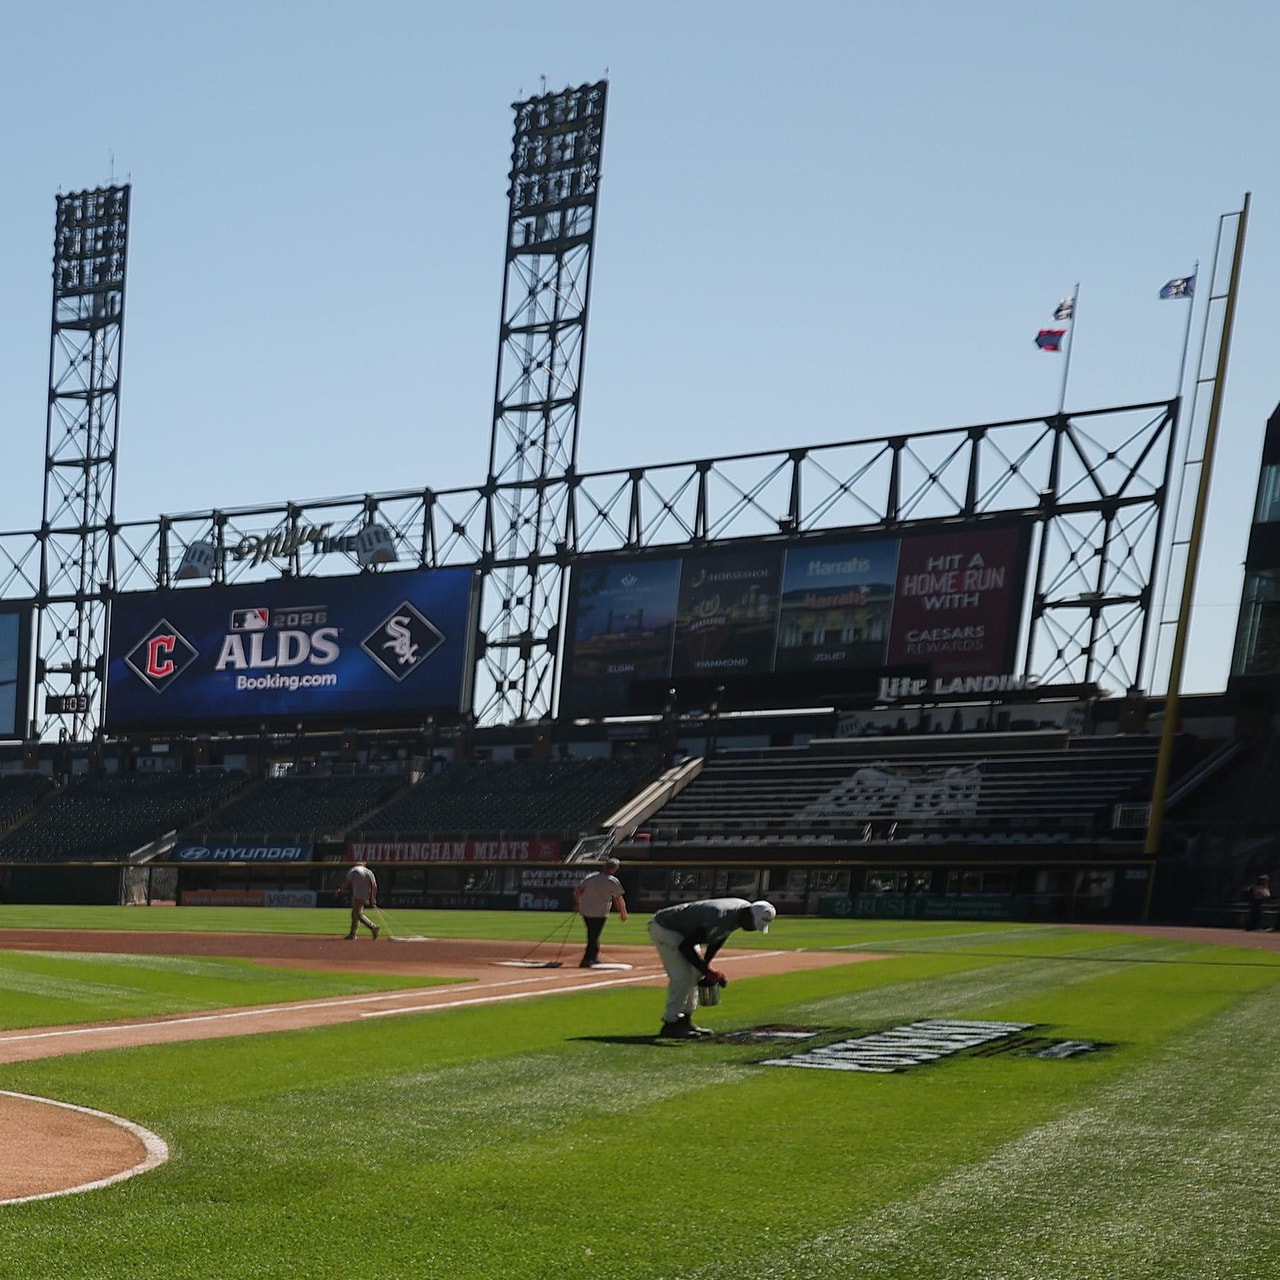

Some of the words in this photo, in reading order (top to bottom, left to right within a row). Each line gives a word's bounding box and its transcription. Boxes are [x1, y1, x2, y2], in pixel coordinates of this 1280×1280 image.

[927, 554, 963, 573] HIT
[968, 552, 985, 568] A
[903, 569, 960, 597] HOME
[964, 566, 1006, 592] RUN
[923, 591, 981, 611] WITH
[272, 610, 328, 628] 2026
[906, 625, 986, 643] CAESARS
[215, 627, 341, 671] ALDS
[814, 650, 848, 662] JOLIET
[906, 639, 985, 656] REWARDS
[608, 664, 635, 674] ELGIN
[695, 657, 749, 669] HAMMOND
[236, 672, 337, 692] Booking.com
[934, 673, 1042, 696] LANDING
[213, 847, 301, 859] HYUNDAI
[351, 843, 471, 861] WHITTINGHAM
[474, 843, 530, 859] MEATS
[520, 892, 559, 910] Rate
[859, 898, 917, 916] RUSH
